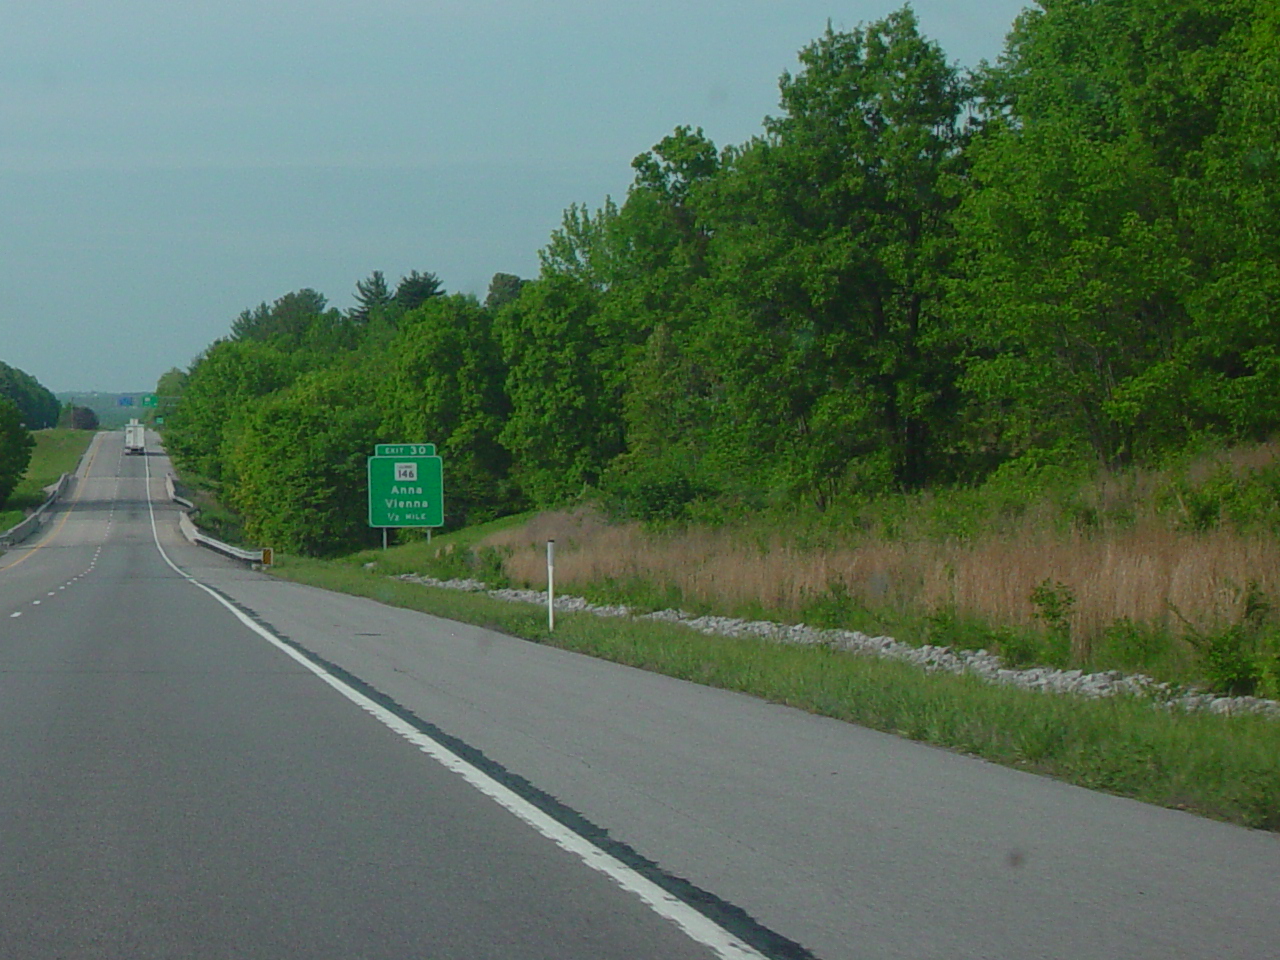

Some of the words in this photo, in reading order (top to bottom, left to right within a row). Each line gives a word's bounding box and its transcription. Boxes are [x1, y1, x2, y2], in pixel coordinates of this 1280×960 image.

[410, 446, 426, 455] 30
[398, 470, 414, 478] 146
[391, 485, 422, 494] Anna
[385, 499, 428, 508] Vienna
